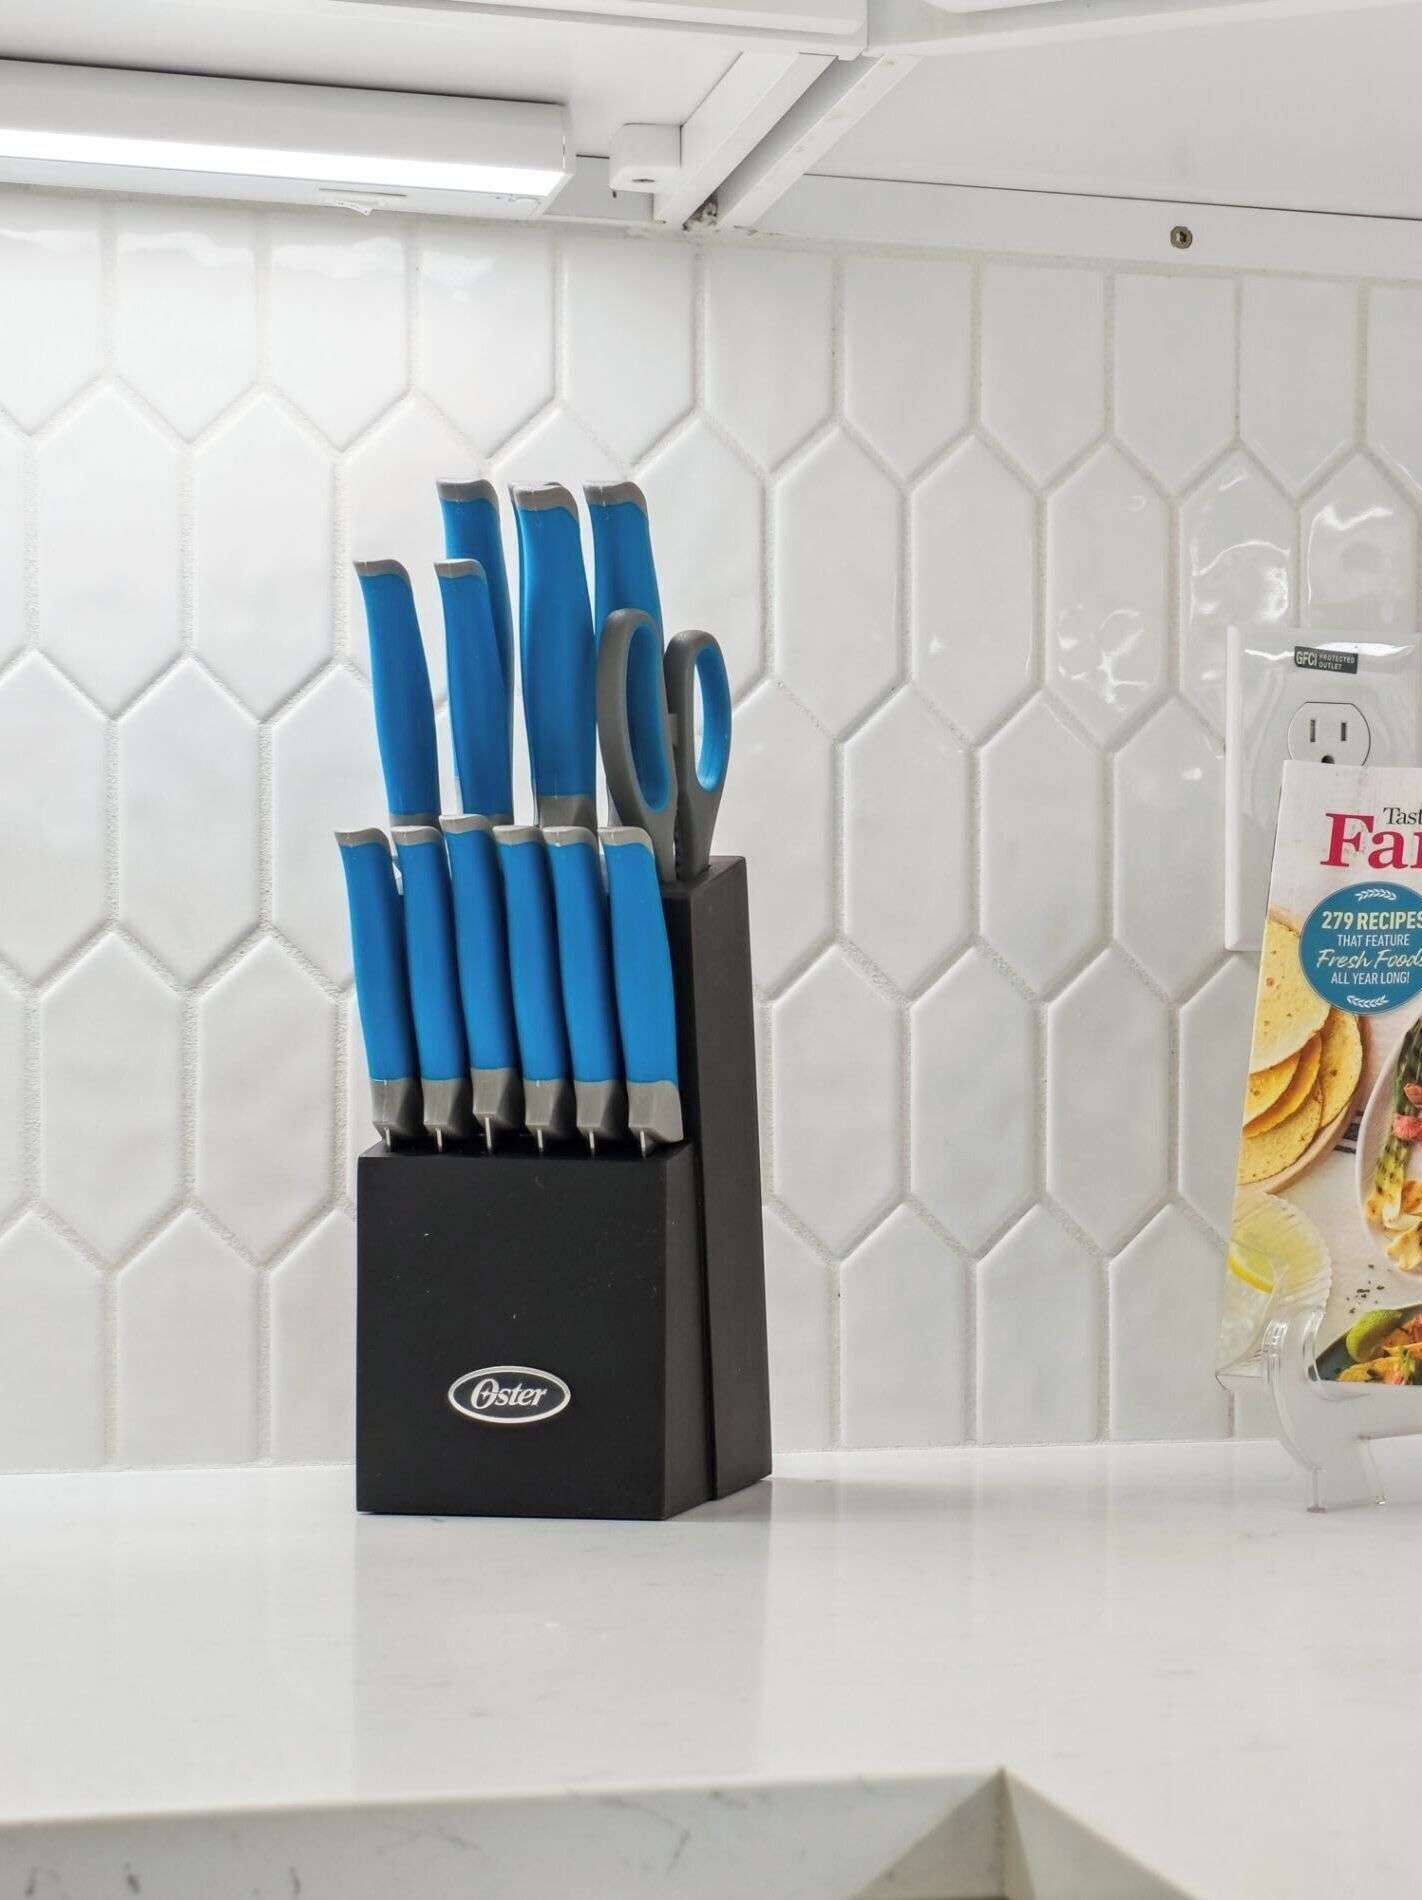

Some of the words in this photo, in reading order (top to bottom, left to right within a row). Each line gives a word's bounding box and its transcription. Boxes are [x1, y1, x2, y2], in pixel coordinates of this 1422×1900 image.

[1296, 651, 1318, 667] GFCI
[1318, 661, 1342, 670] OUTLET
[1319, 653, 1355, 664] PROTECTED
[1321, 911, 1354, 930] 279
[1337, 934, 1362, 947] THAT
[1365, 933, 1410, 947] FEATURE
[1316, 948, 1372, 969] Fresh
[1330, 972, 1350, 984] ALL
[1352, 972, 1378, 985] YEAR
[1380, 971, 1410, 984] LONG!
[471, 1378, 547, 1409] Oster
